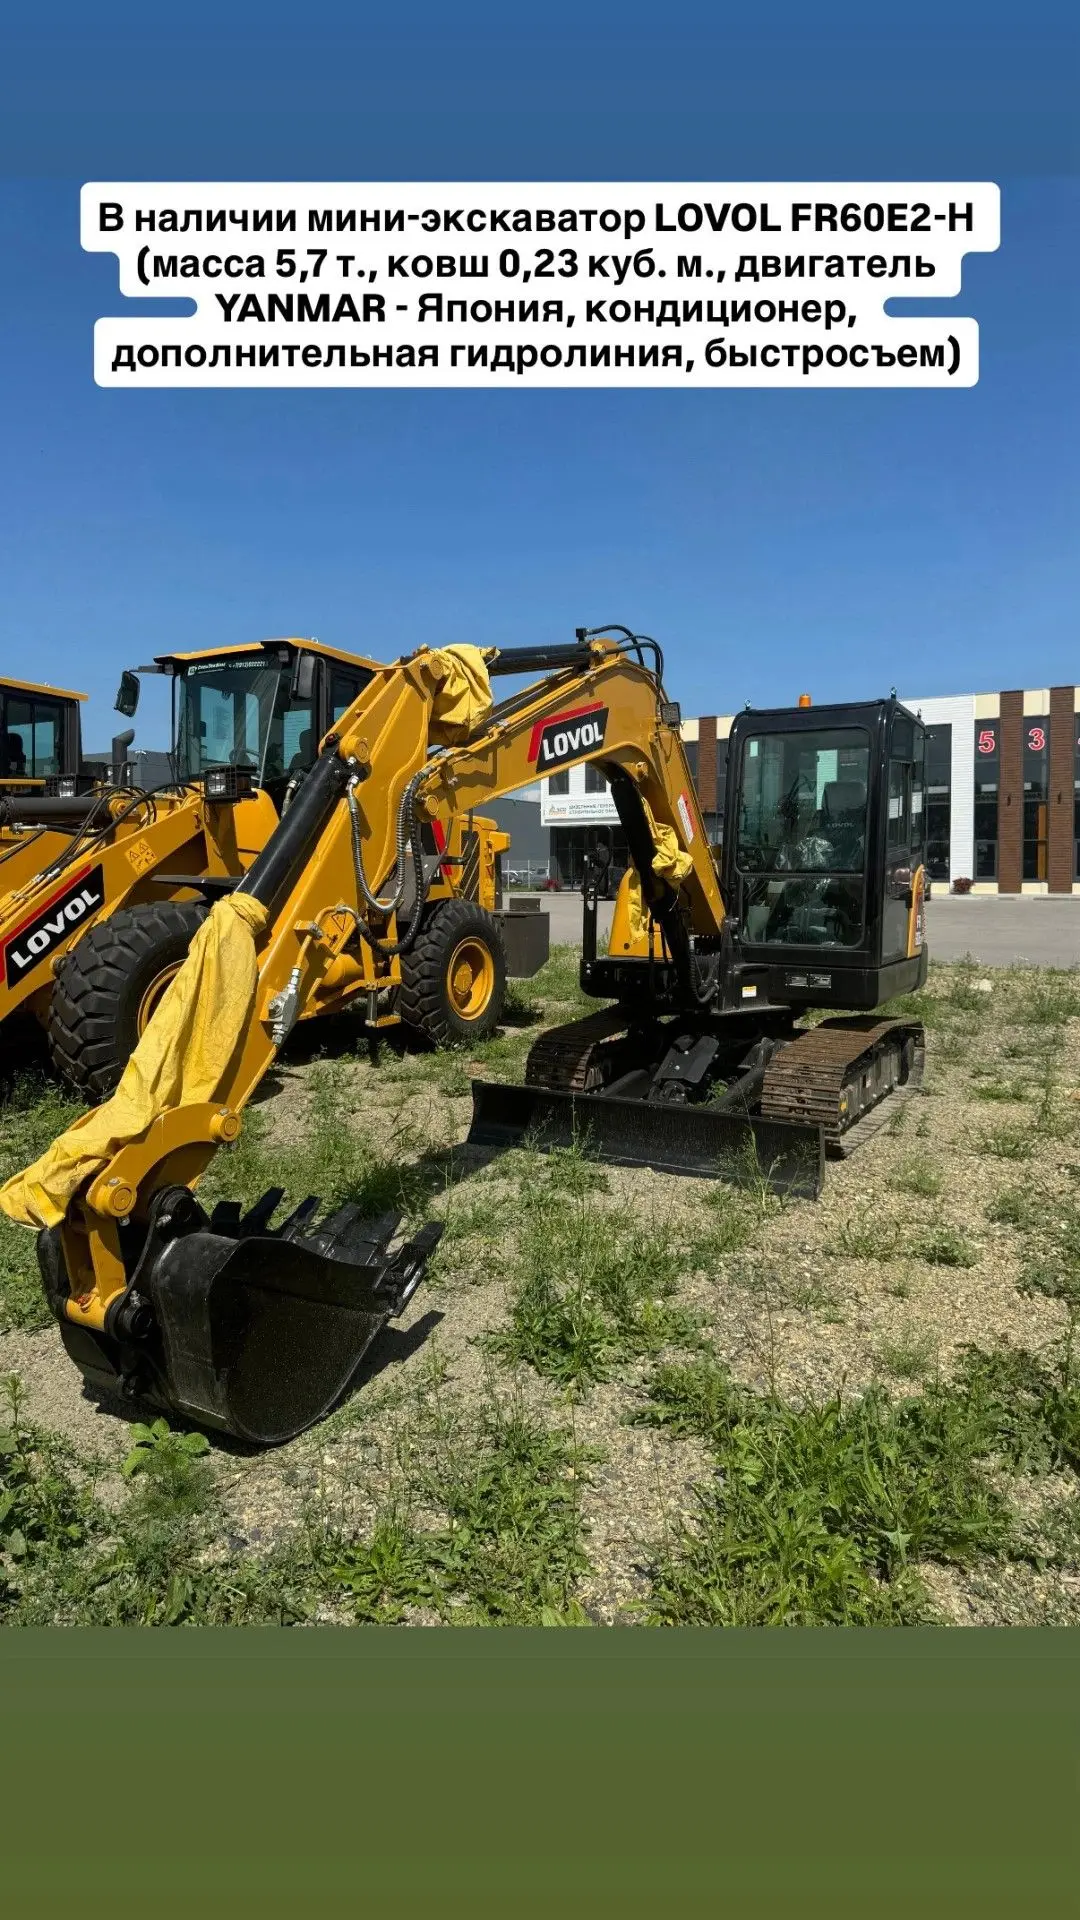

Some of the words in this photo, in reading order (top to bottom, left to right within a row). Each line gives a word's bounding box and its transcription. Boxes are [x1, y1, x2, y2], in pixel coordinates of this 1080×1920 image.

[542, 721, 604, 761] LOVOL
[978, 730, 996, 754] 5
[1027, 727, 1046, 751] 3
[10, 889, 101, 969] LOVOL
